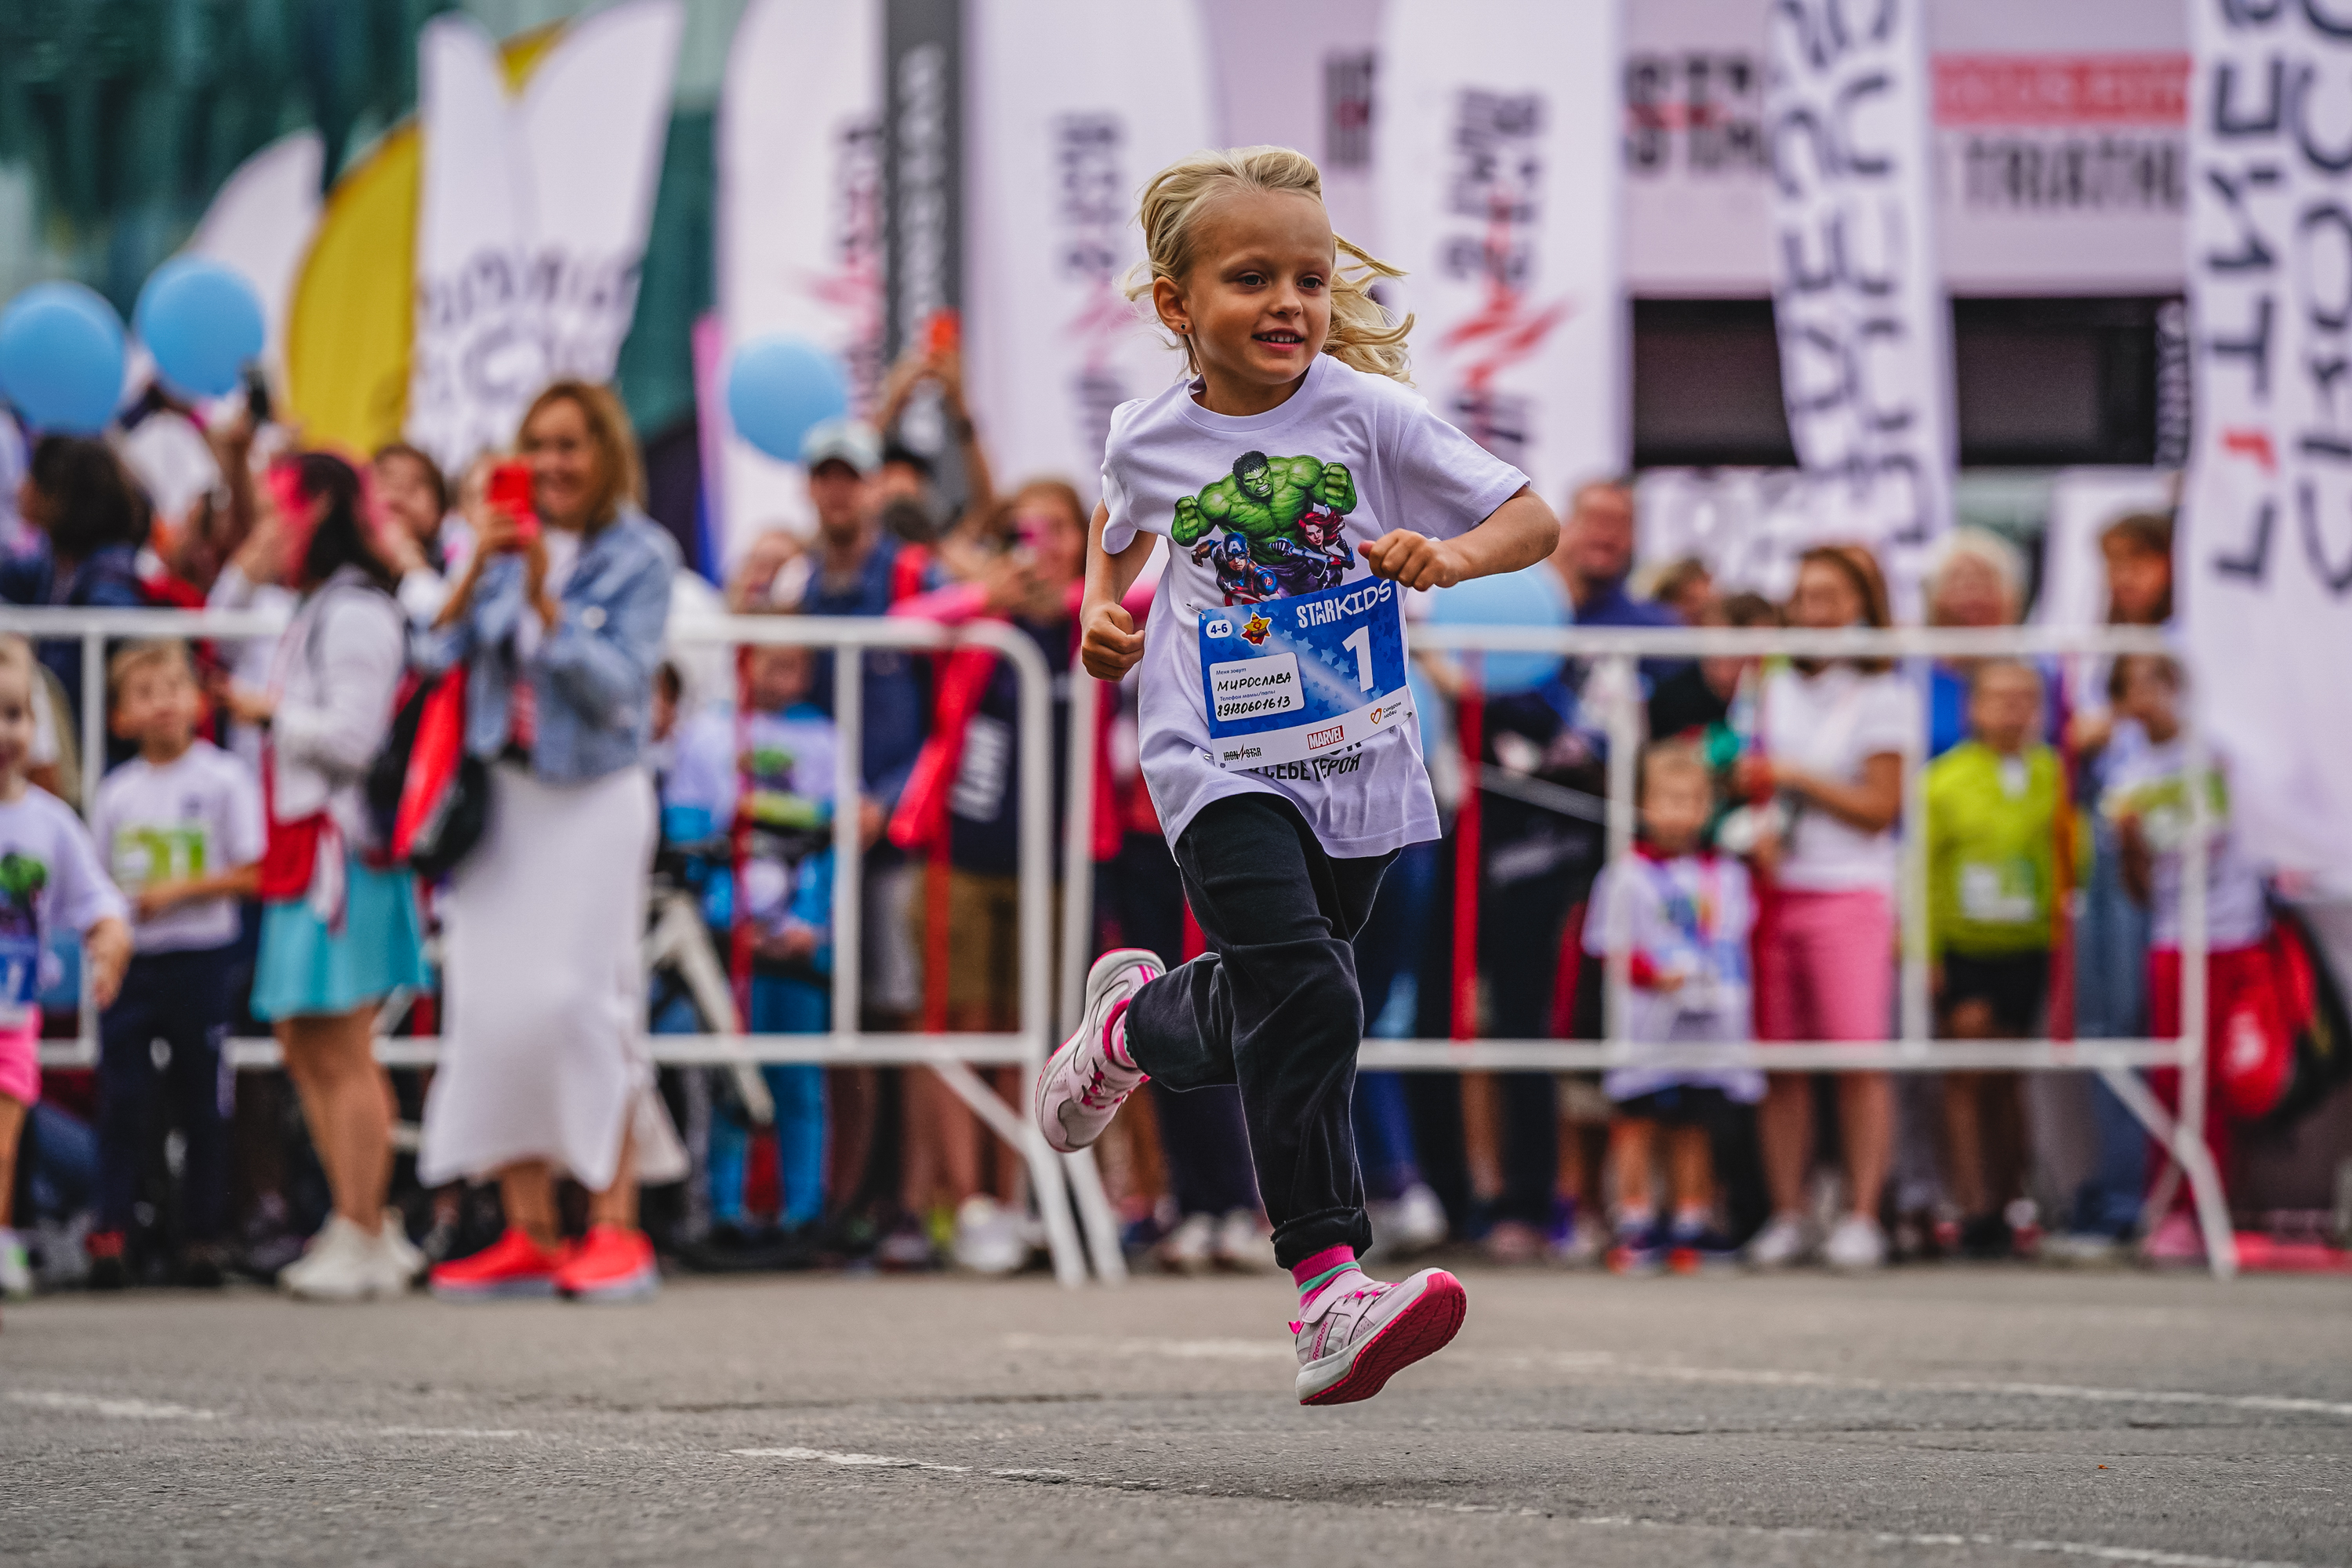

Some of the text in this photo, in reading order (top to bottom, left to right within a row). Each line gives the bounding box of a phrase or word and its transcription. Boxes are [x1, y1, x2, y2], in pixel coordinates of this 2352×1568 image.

[1210, 623, 1228, 636] 4-6
[1341, 625, 1374, 692] 1
[1217, 672, 1291, 691] МИРОСЛАВА
[1217, 695, 1290, 717] 89180601613
[1308, 726, 1344, 750] MARVEL
[1312, 753, 1363, 782] ГЕРОЯ
[1312, 1321, 1328, 1360] Reebok
